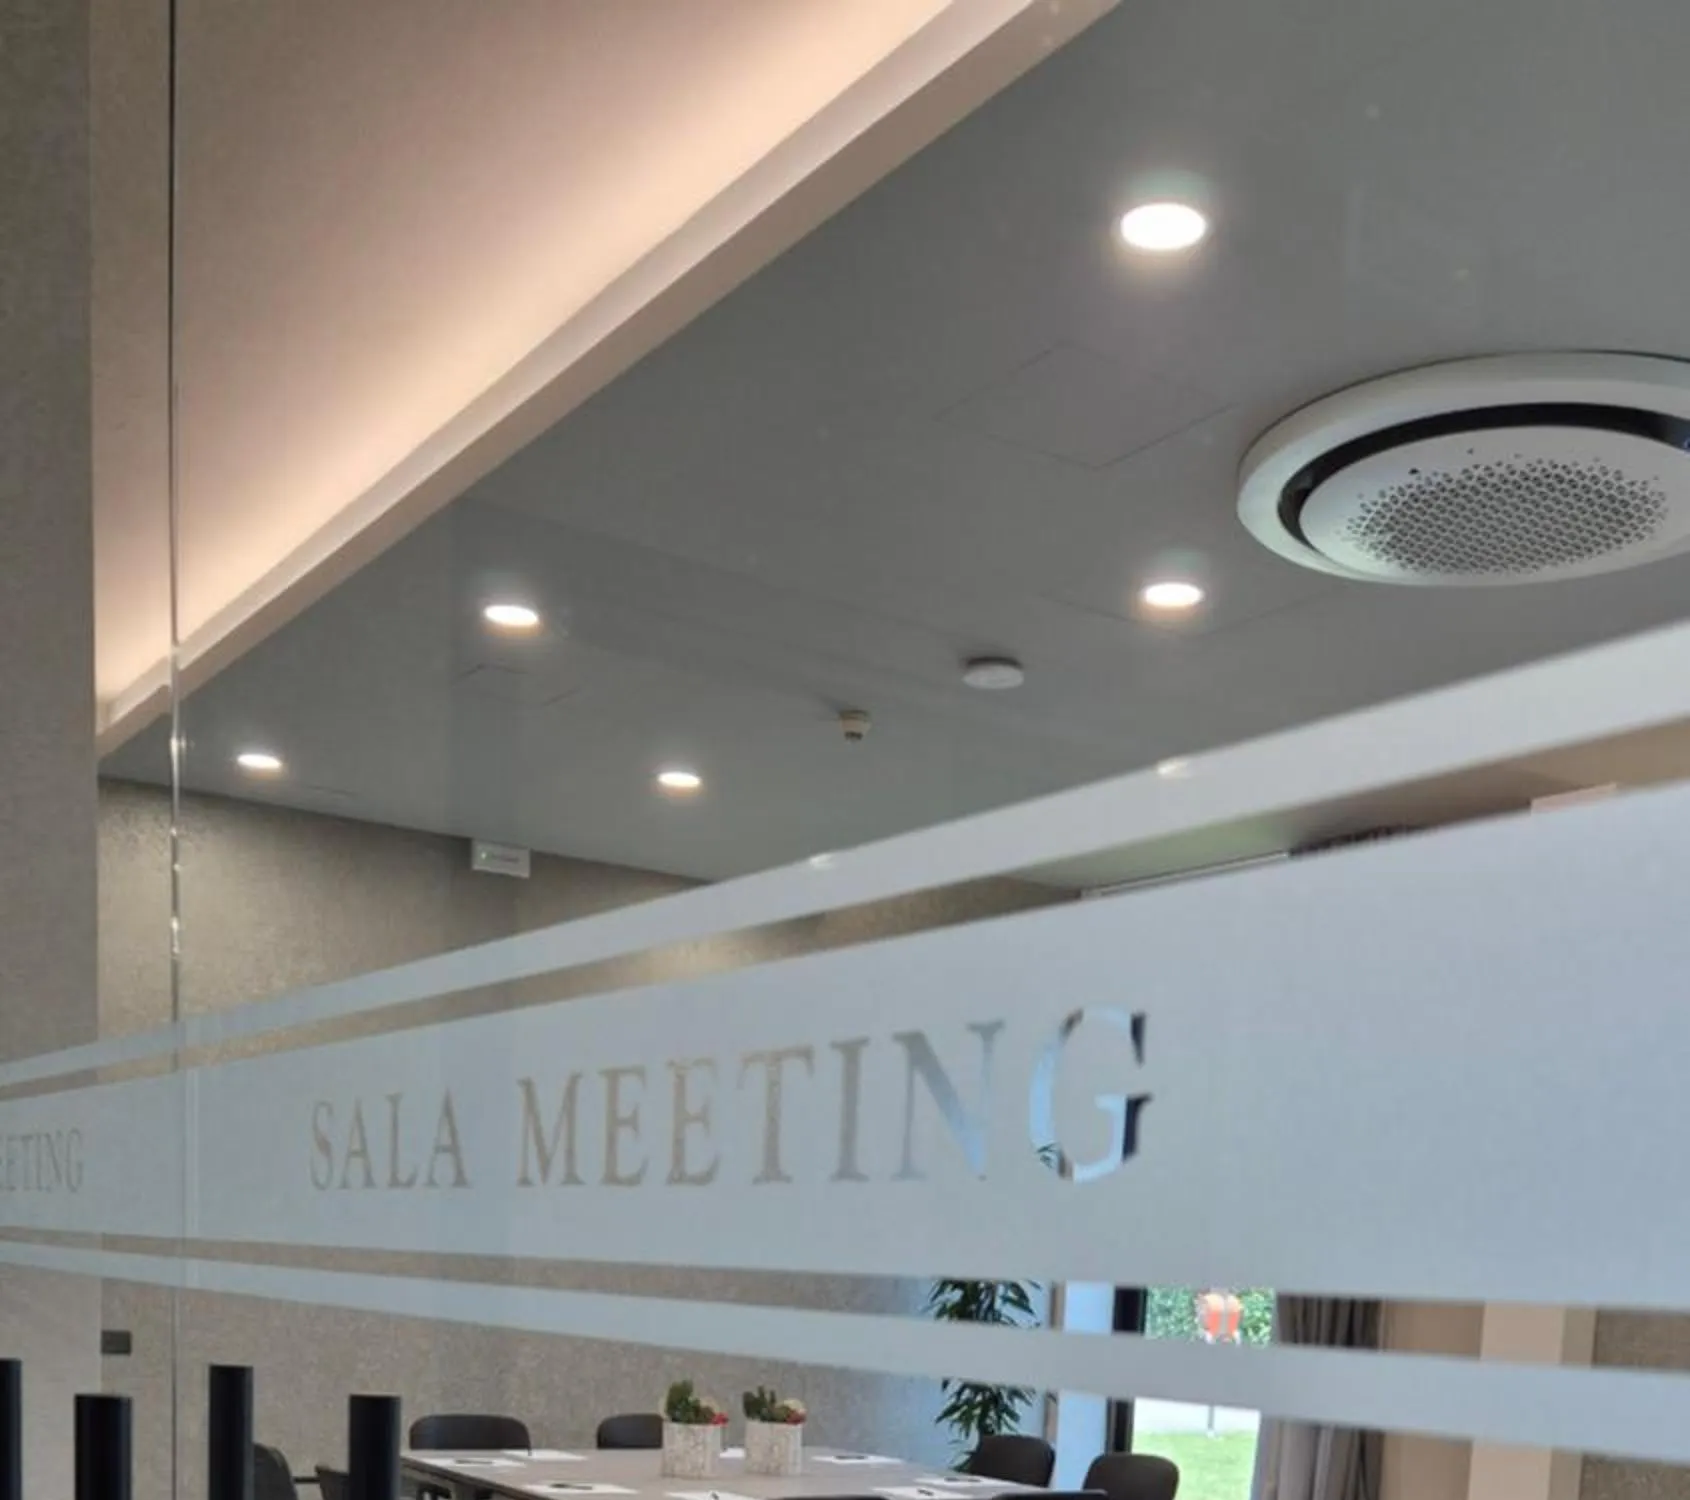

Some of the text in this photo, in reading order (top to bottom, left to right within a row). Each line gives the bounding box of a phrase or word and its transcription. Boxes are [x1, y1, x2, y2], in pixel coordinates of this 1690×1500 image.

[0, 1127, 84, 1193] ETING
[309, 1007, 1153, 1191] SALA MEETING
